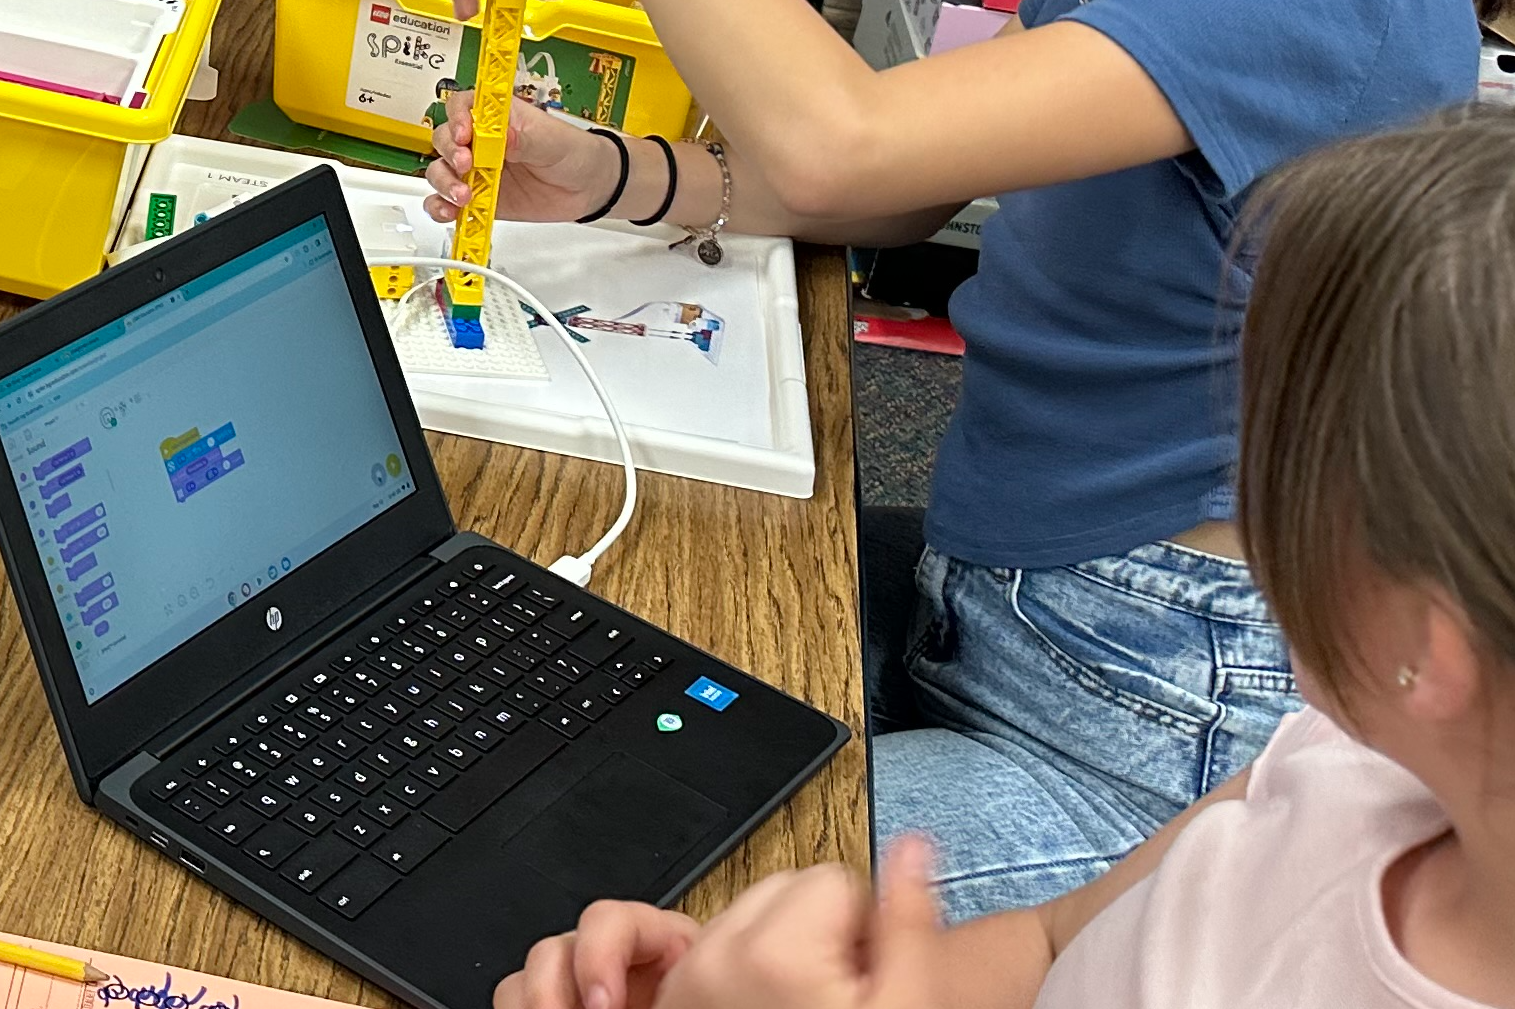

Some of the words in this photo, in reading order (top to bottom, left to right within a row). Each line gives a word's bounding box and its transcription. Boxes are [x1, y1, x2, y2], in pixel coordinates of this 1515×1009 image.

[392, 14, 451, 36] education
[358, 93, 375, 104] 6+
[218, 174, 269, 188] STEAM
[268, 606, 282, 631] hp
